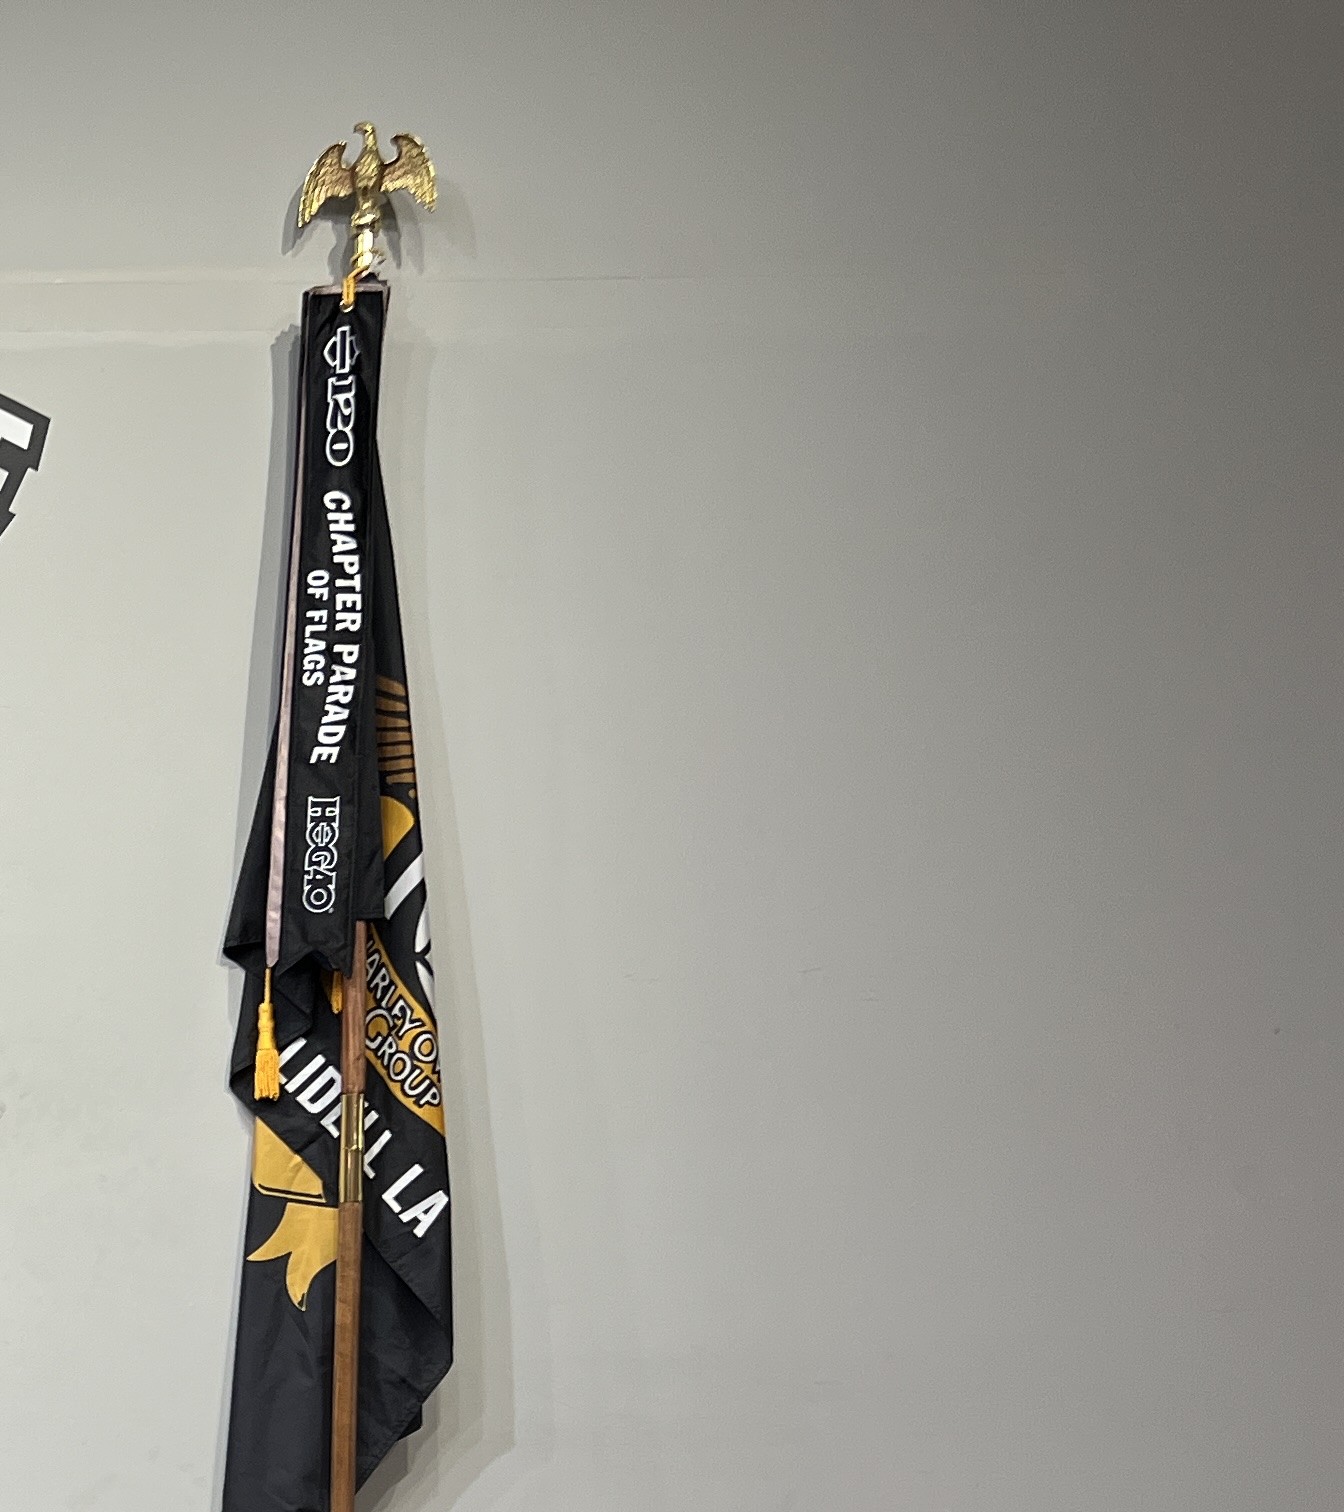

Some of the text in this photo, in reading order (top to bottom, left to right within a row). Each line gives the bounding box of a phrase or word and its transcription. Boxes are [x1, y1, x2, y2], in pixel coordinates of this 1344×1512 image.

[301, 568, 330, 687] OF FLAGS
[309, 489, 363, 765] CHAPTER PARADE
[366, 1008, 441, 1107] GROUP
[381, 1163, 449, 1238] LA
